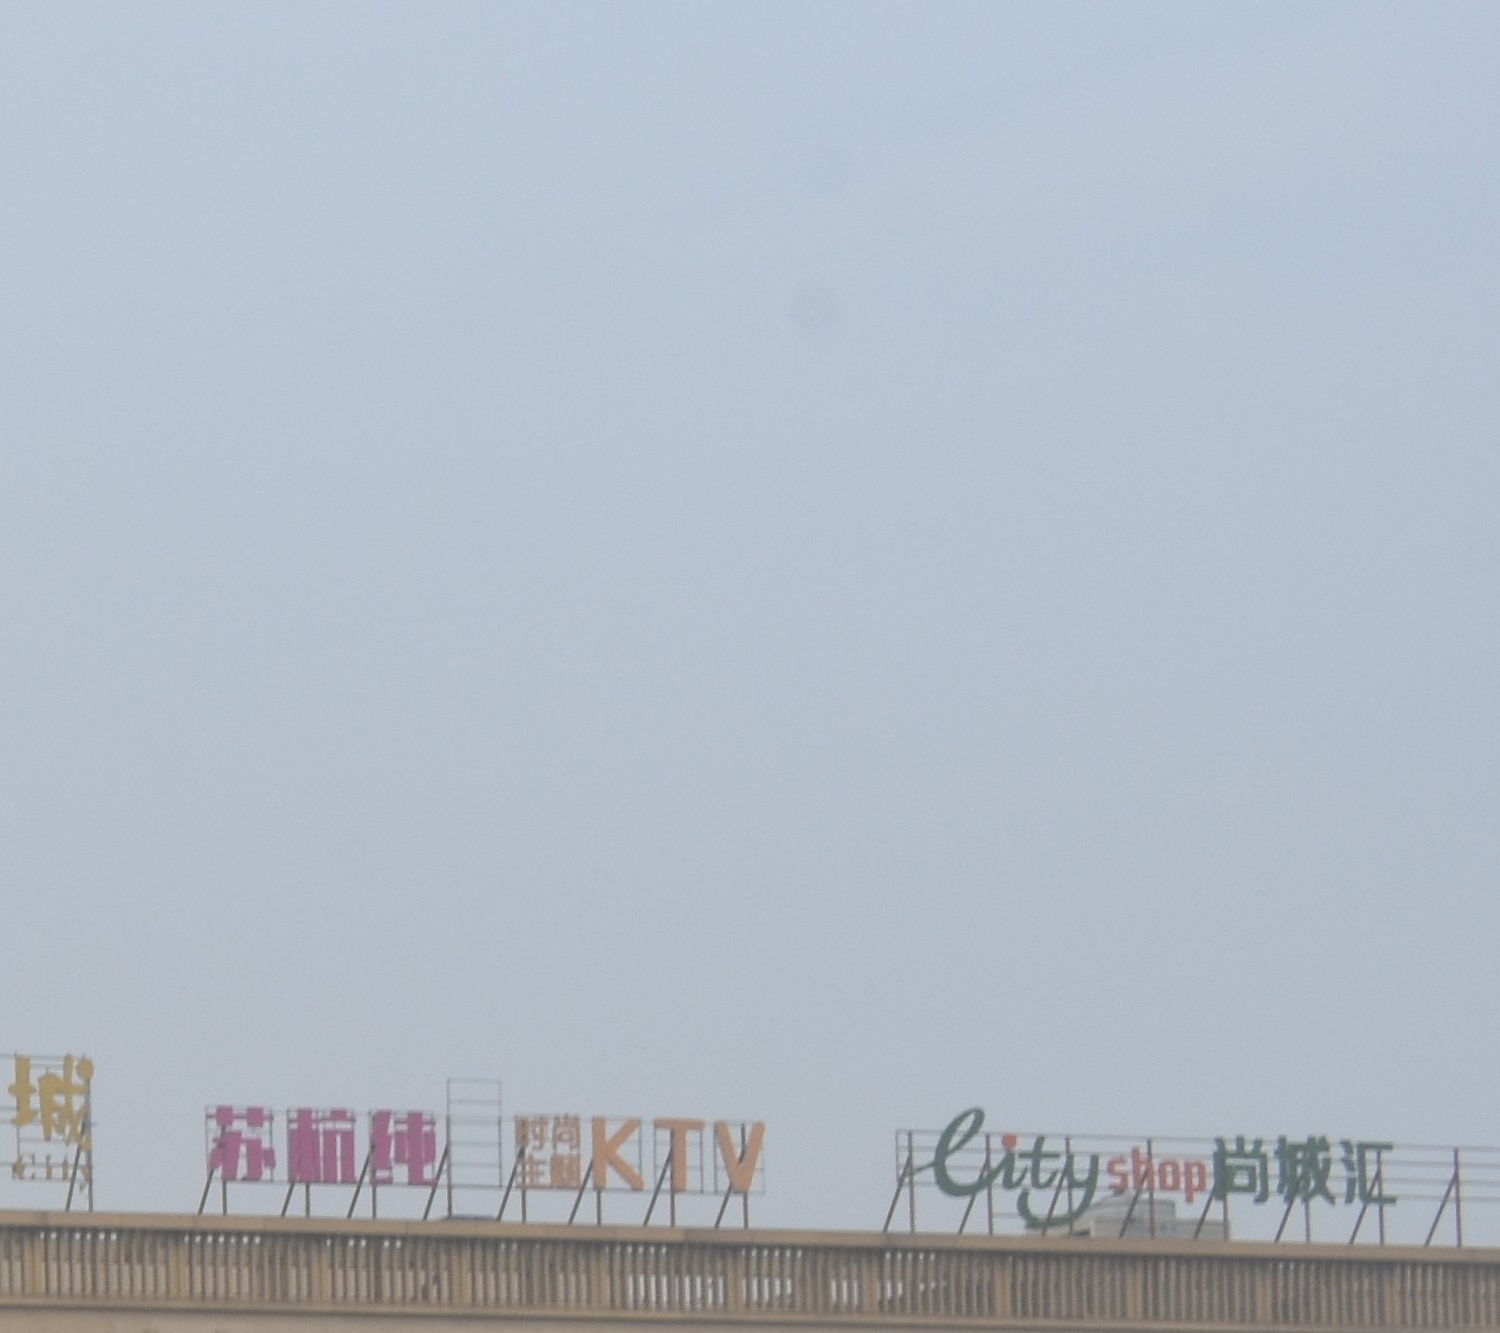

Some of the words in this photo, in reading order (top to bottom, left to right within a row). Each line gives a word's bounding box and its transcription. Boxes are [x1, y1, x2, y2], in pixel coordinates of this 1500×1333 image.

[592, 1116, 765, 1193] KTV
[1107, 1147, 1208, 1204] shop
[1213, 1134, 1397, 1205] 尚城汇
